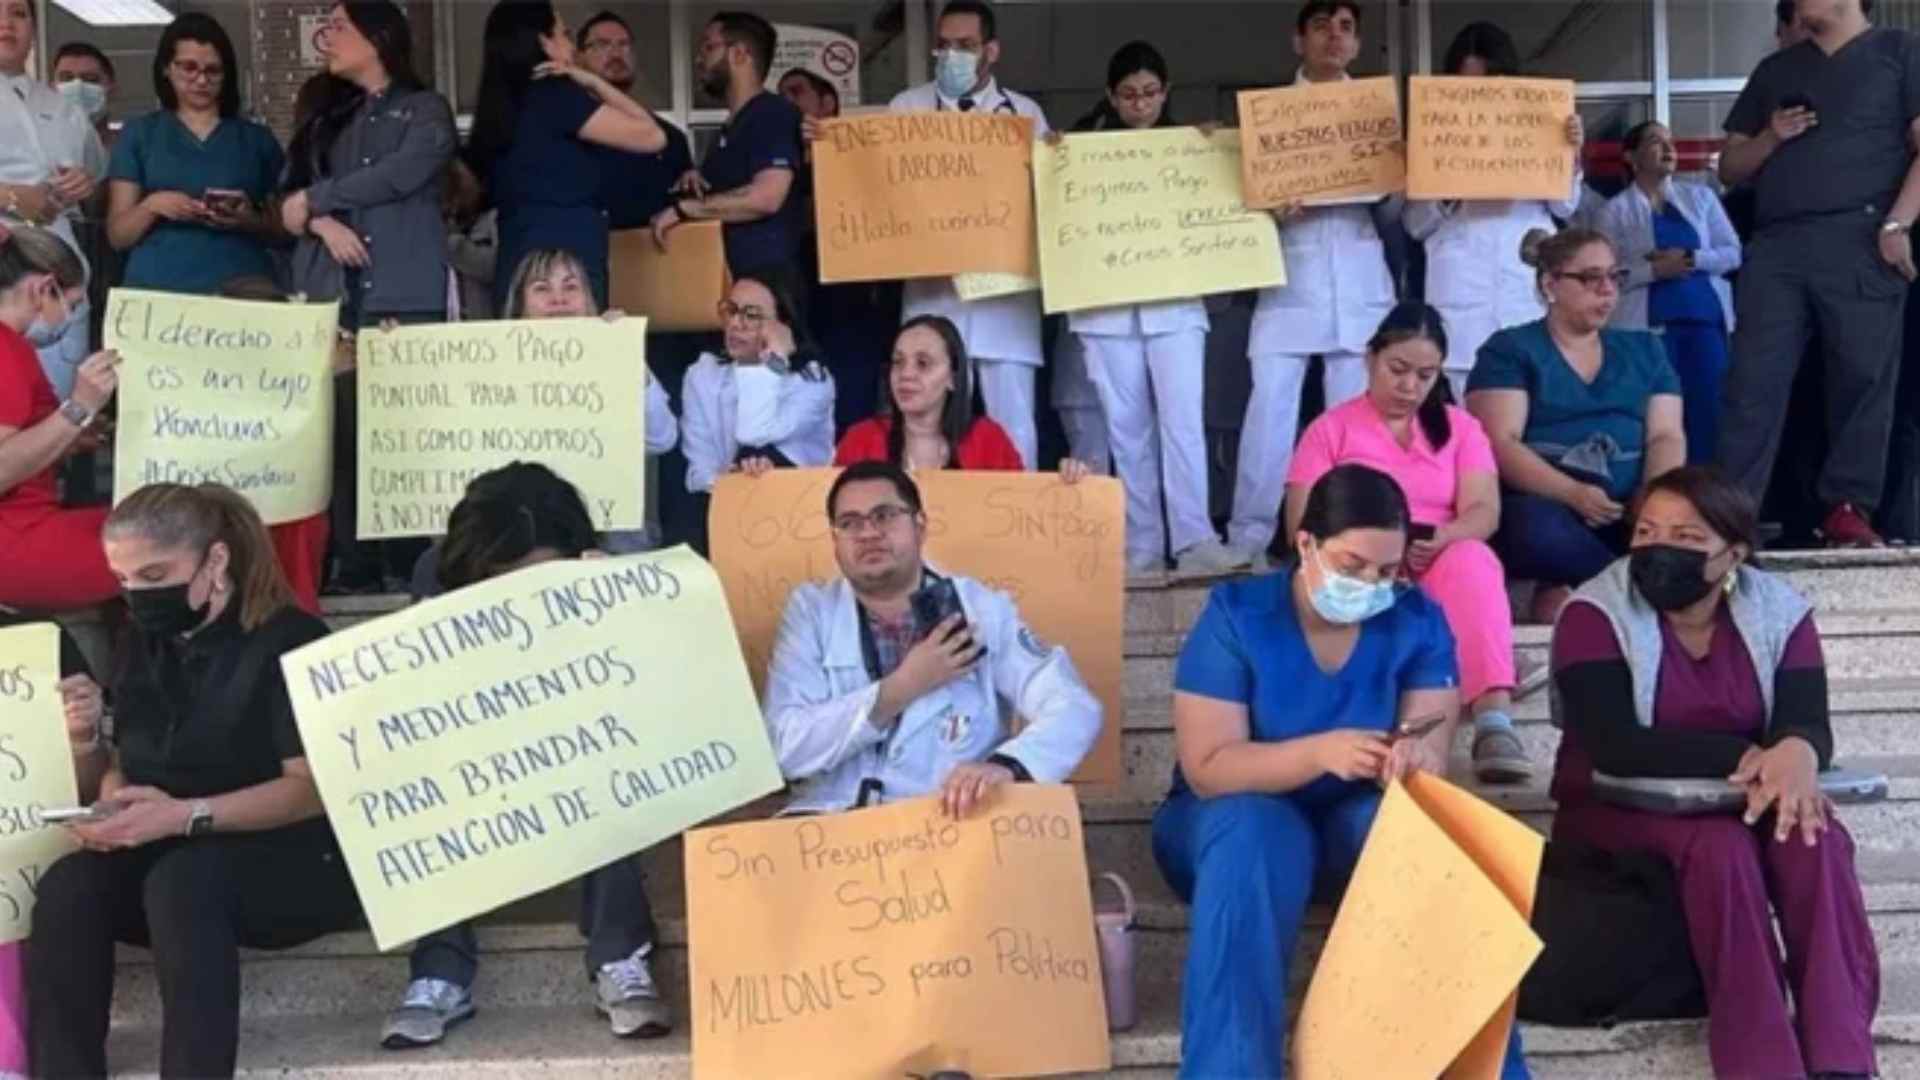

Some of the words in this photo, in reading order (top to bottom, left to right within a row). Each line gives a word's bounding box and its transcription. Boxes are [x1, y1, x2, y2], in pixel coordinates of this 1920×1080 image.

[159, 312, 273, 350] derecho
[367, 338, 497, 368] EXIGIMOS
[368, 381, 452, 409] PUNTUAL
[463, 380, 517, 407] PARA
[528, 380, 604, 414] TODOS
[416, 427, 473, 454] COMO
[481, 427, 604, 460] NOSOTROS
[309, 596, 533, 701] NECESITAMOS
[533, 559, 681, 631] INSUMOS
[338, 726, 361, 771] Y
[377, 645, 637, 752] MEDICAMENTOS
[350, 776, 447, 829] PARA
[451, 712, 638, 799] BRINDAR
[556, 789, 600, 828] DE
[609, 739, 737, 810] CALIDAD
[706, 833, 775, 881] Sin
[796, 820, 960, 883] Presupuesto
[989, 811, 1071, 865] para
[836, 870, 952, 933] Salud
[709, 956, 887, 1035] MILLONES
[908, 956, 972, 998] para
